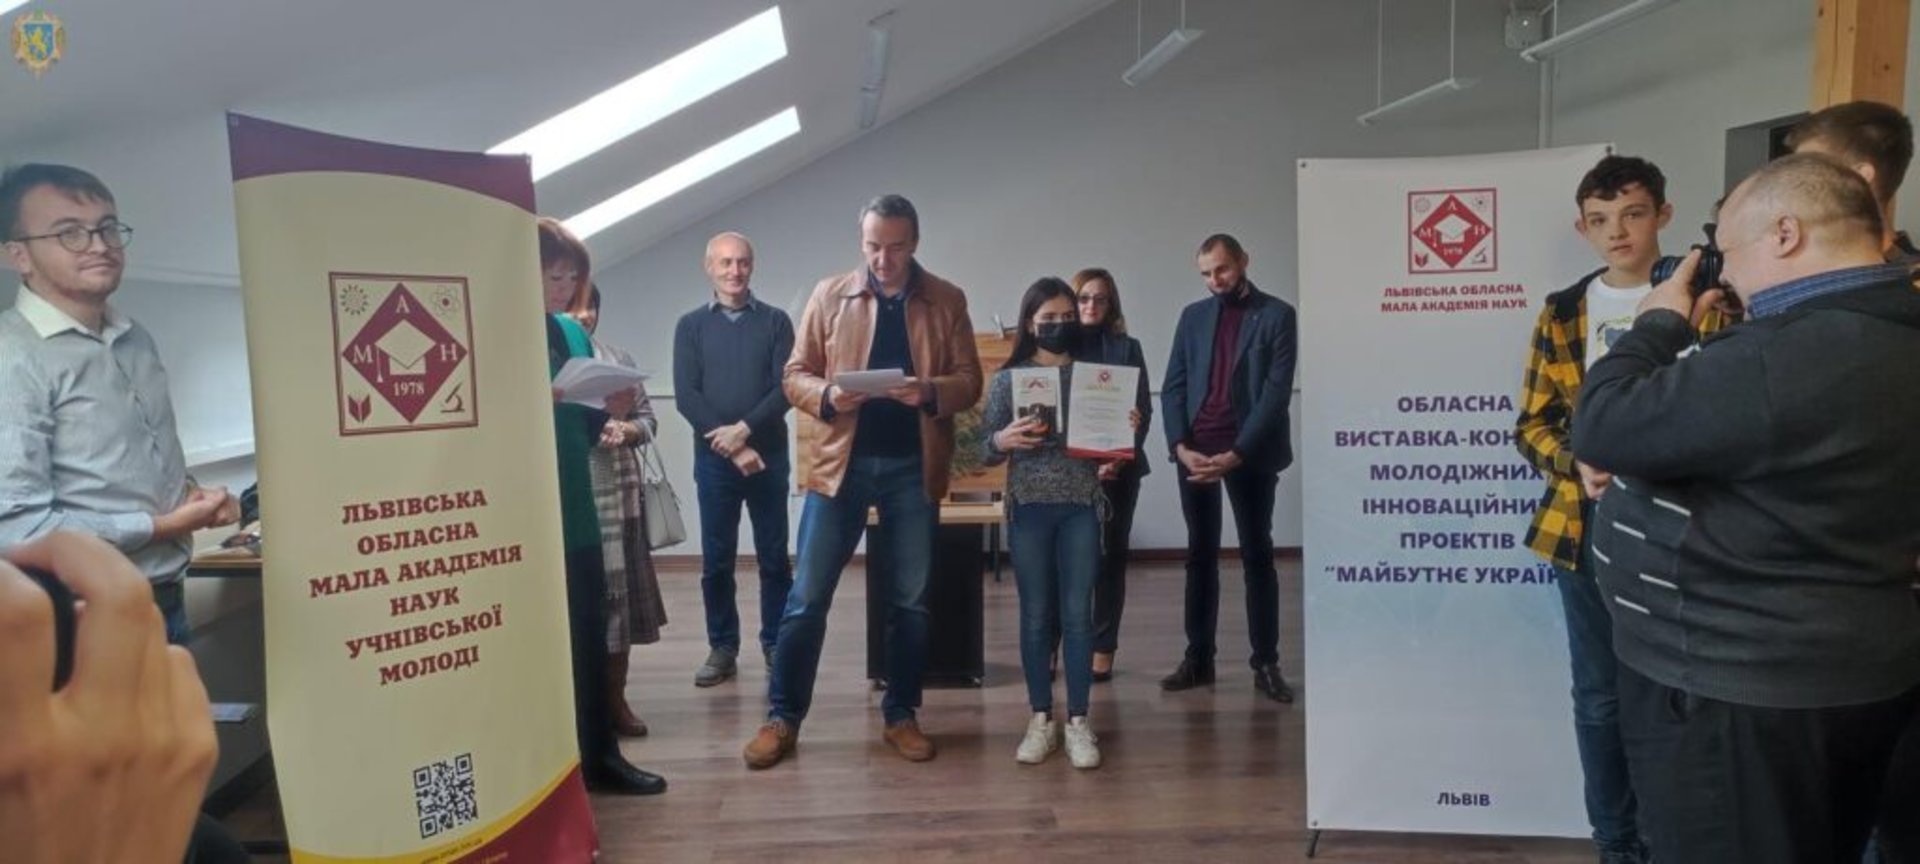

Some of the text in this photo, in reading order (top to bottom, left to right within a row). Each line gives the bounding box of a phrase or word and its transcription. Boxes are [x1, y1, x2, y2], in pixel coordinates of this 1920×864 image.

[1384, 283, 1525, 297] ЛЬВІВСЬКА ОБЛАСНА
[396, 294, 411, 315] А
[1381, 298, 1528, 313] МАЛА АКАДЕМІЯ НАУК
[353, 343, 459, 365] М Н
[393, 381, 426, 397] 1978
[1398, 395, 1514, 413] ОБЛАСНА
[1335, 430, 1518, 447] ВИСТАВКА-КОН
[1370, 464, 1545, 484] МОЛОДІЖНИХ
[342, 489, 488, 525] ЛЬВІВСЬКА
[1363, 494, 1540, 518] ІННОВАЦІЙНИ
[357, 521, 479, 556] ОБЛАСНА
[1401, 532, 1516, 550] ПРОЕКТІВ
[309, 544, 523, 598] МАЛА АКАДЕМІЯ
[1475, 563, 1558, 584] УКРАЇН
[390, 586, 460, 617] НАУК
[346, 604, 503, 659] УЧНІВСЬКОЇ
[379, 645, 480, 686] МОЛОДІ
[1437, 792, 1491, 807] ЛЬВІВ
